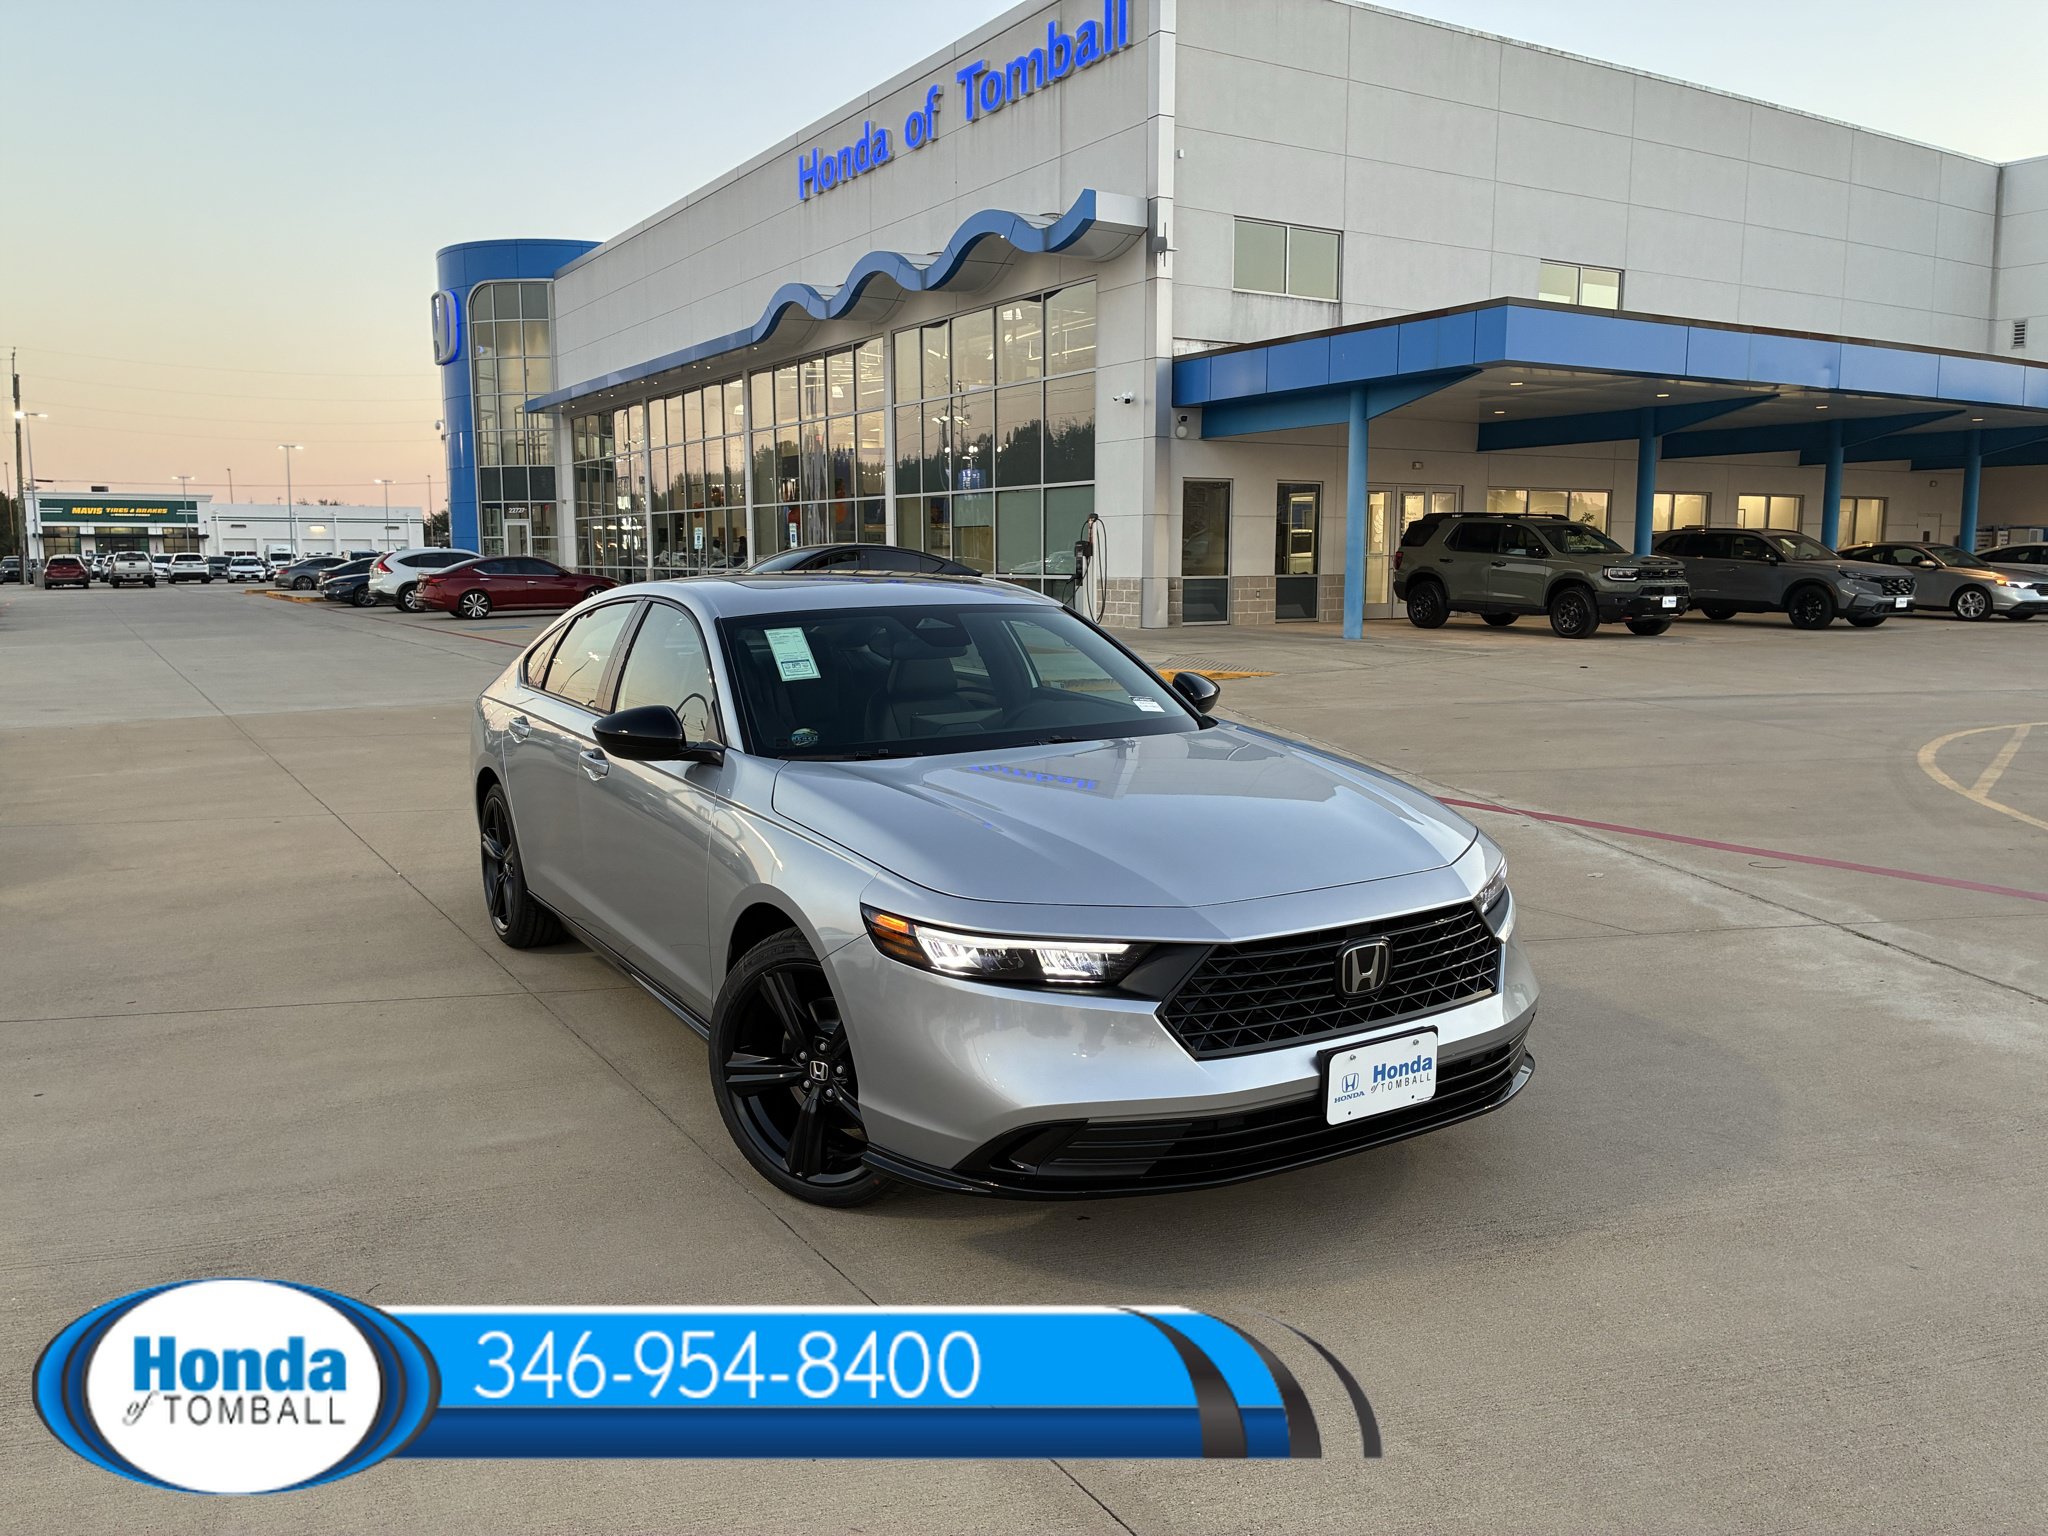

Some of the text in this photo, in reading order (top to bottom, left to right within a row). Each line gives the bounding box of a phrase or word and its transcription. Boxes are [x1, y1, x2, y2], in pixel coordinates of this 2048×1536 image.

[799, 0, 1131, 200] Honda of Tomball
[1373, 1055, 1432, 1083] Honda
[1371, 1073, 1431, 1093] of TOMBALL
[1334, 1091, 1365, 1103] HONDA
